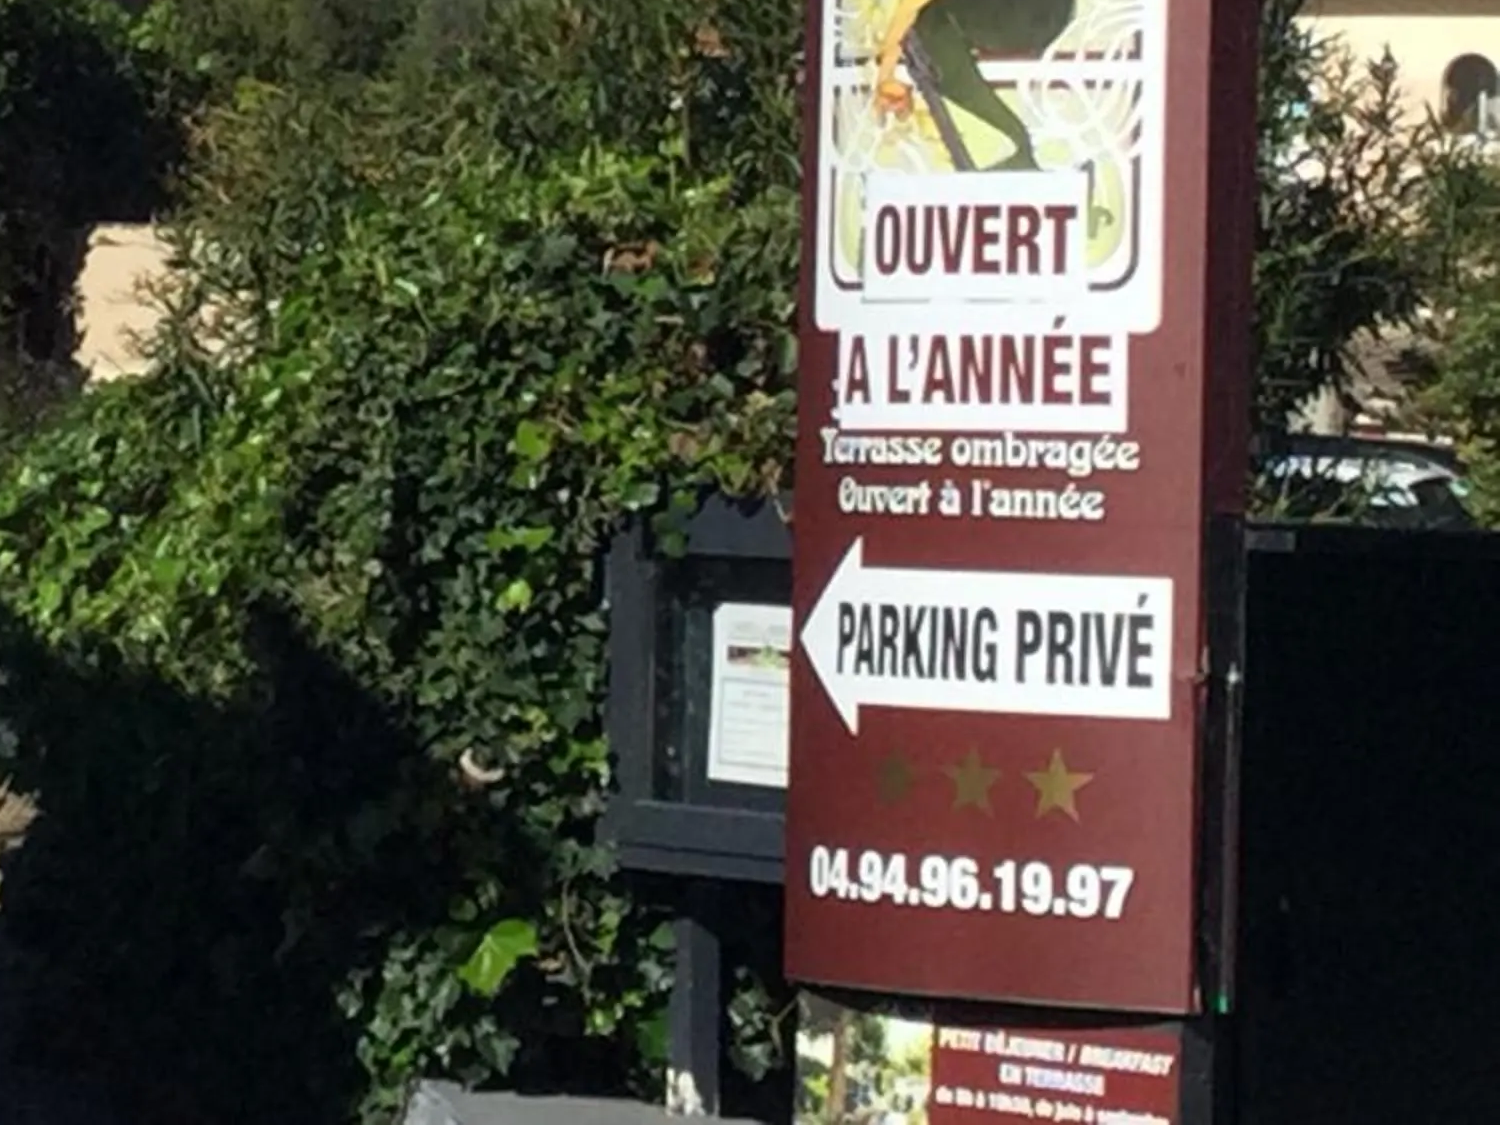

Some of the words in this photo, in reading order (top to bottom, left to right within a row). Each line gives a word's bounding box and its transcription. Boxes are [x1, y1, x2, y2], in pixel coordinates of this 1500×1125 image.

[874, 205, 1077, 276] OUVERT
[845, 334, 871, 404] A
[888, 315, 1112, 405] L'ANNÉE
[820, 427, 943, 465] Terrasse
[951, 432, 1140, 476] ombragée
[838, 477, 932, 514] Ouvert
[938, 478, 961, 517] à
[971, 480, 1105, 520] l'année
[836, 601, 998, 682] PARKING
[1014, 593, 1154, 688] PRIVÉ
[809, 844, 1134, 919] 04.94.96.19.97
